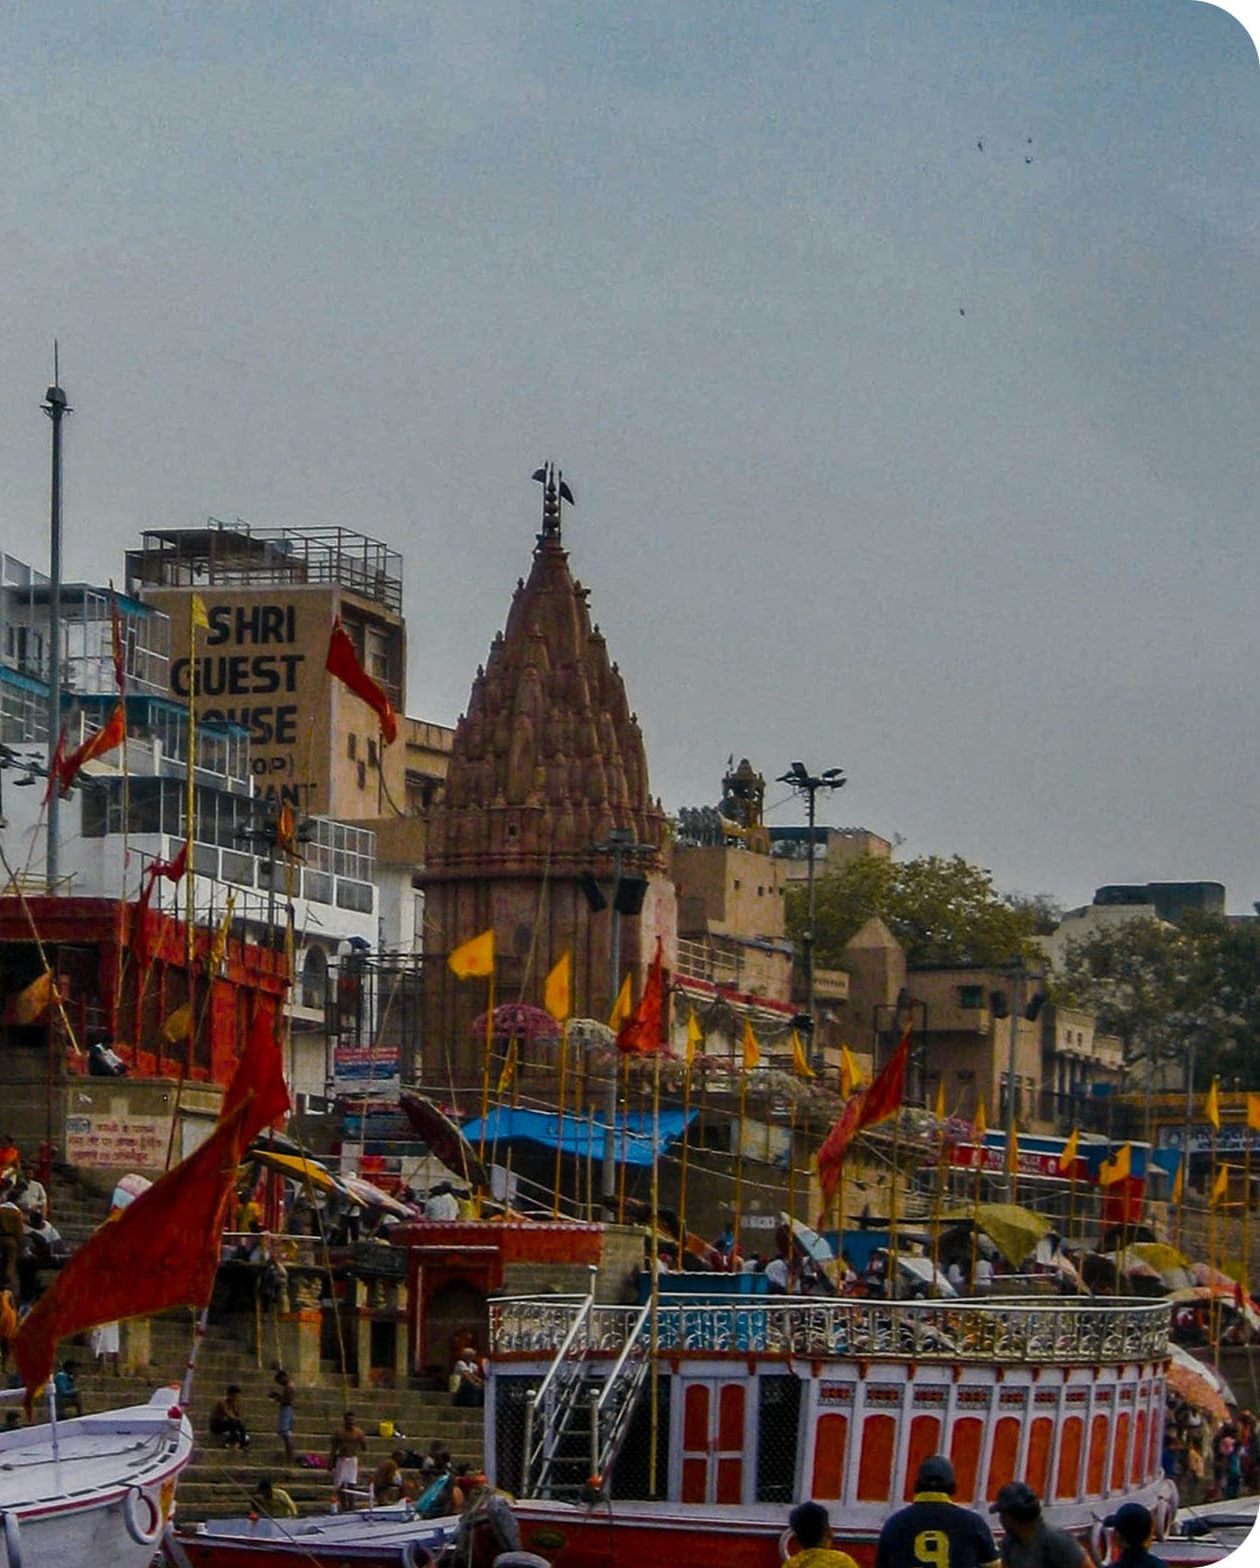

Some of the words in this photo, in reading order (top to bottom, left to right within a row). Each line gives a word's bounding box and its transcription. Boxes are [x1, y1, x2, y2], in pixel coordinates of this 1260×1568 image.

[207, 605, 295, 645] SHRI
[170, 654, 305, 697] GUEST
[195, 706, 297, 744] USE
[249, 753, 294, 777] OP)
[914, 1529, 950, 1568] 9
